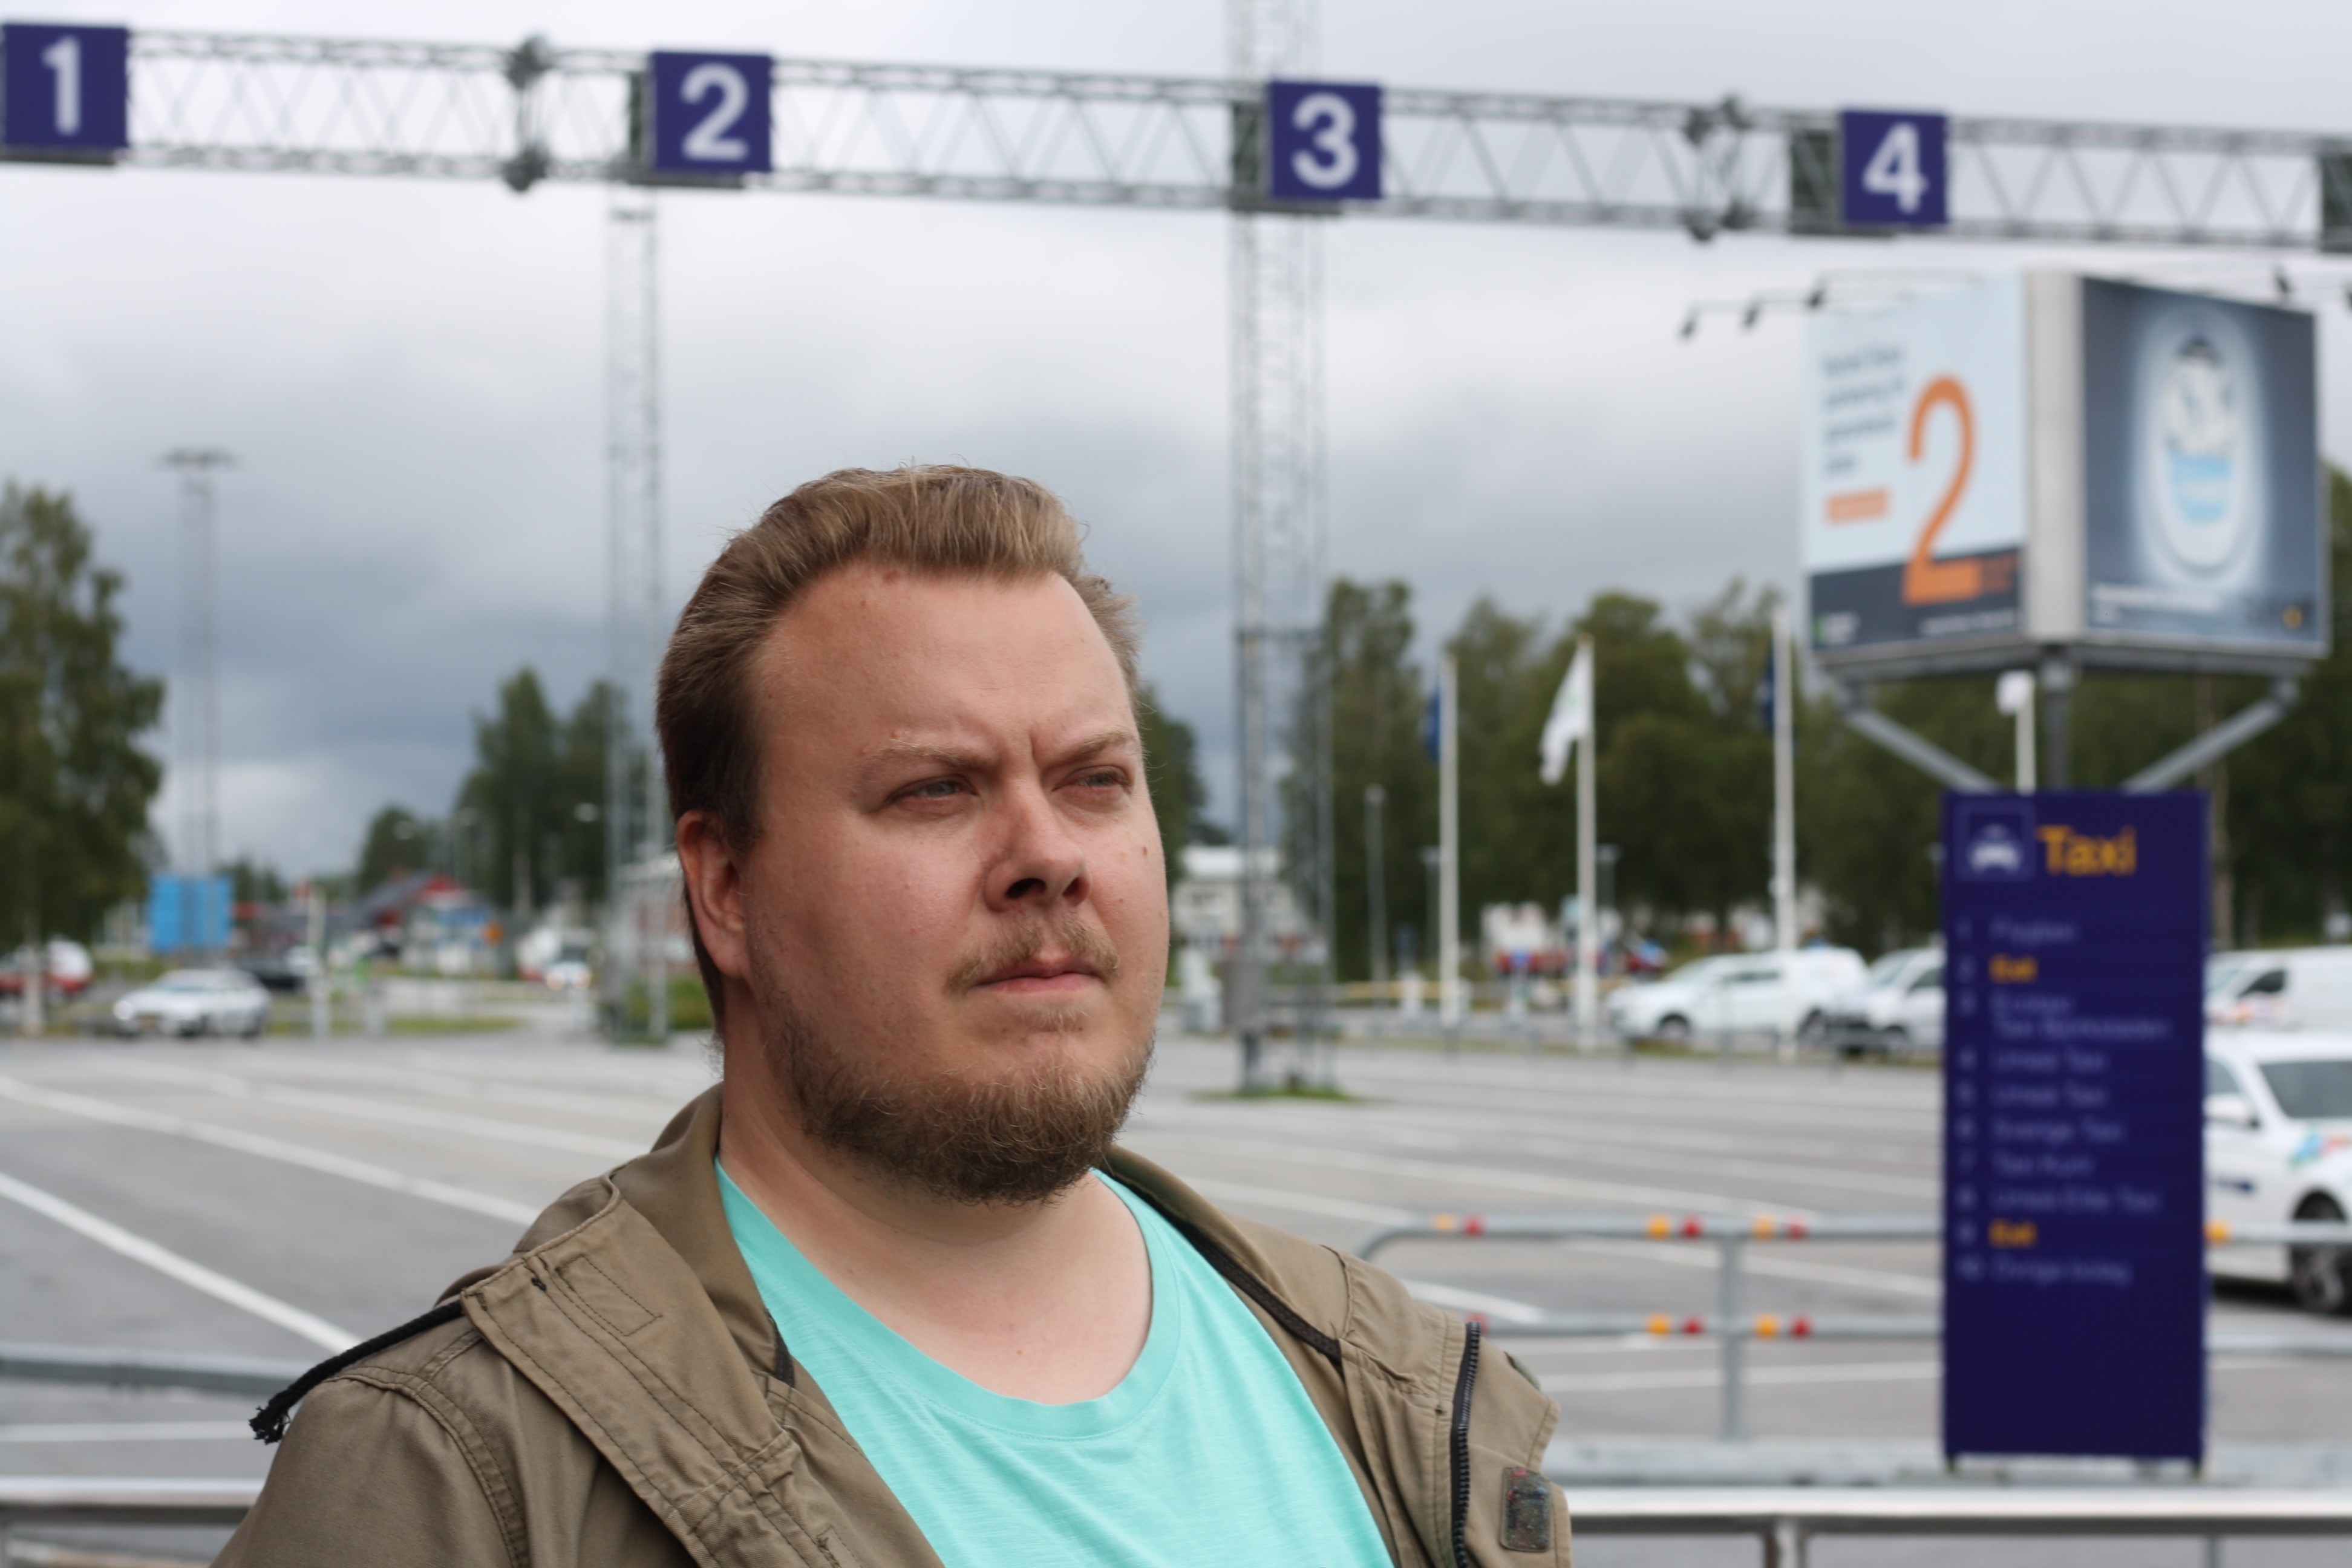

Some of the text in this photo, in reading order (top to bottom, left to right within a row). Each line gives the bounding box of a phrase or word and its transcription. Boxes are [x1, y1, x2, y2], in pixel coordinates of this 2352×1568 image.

[42, 36, 81, 134] 1
[681, 63, 748, 162] 2
[1291, 93, 1359, 189] 3
[1862, 122, 1929, 214] 4
[1904, 372, 1982, 605] 2
[2036, 824, 2138, 875] Taxi
